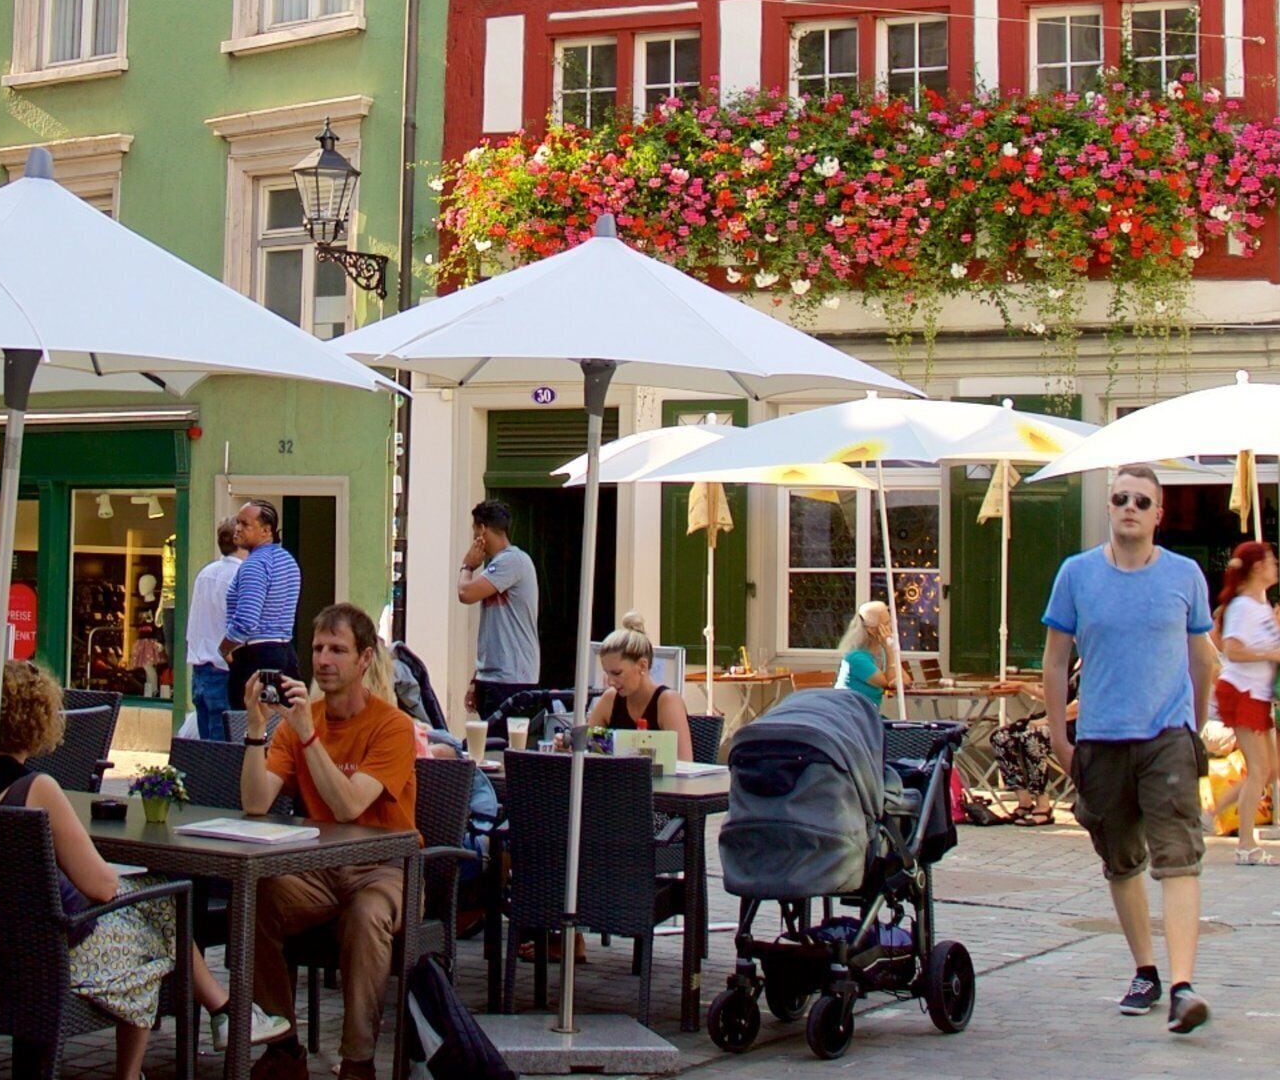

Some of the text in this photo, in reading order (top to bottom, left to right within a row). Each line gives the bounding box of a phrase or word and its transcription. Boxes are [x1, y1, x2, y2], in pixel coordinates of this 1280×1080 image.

[536, 389, 551, 403] 30
[278, 440, 293, 454] 32
[15, 631, 37, 640] ENKT
